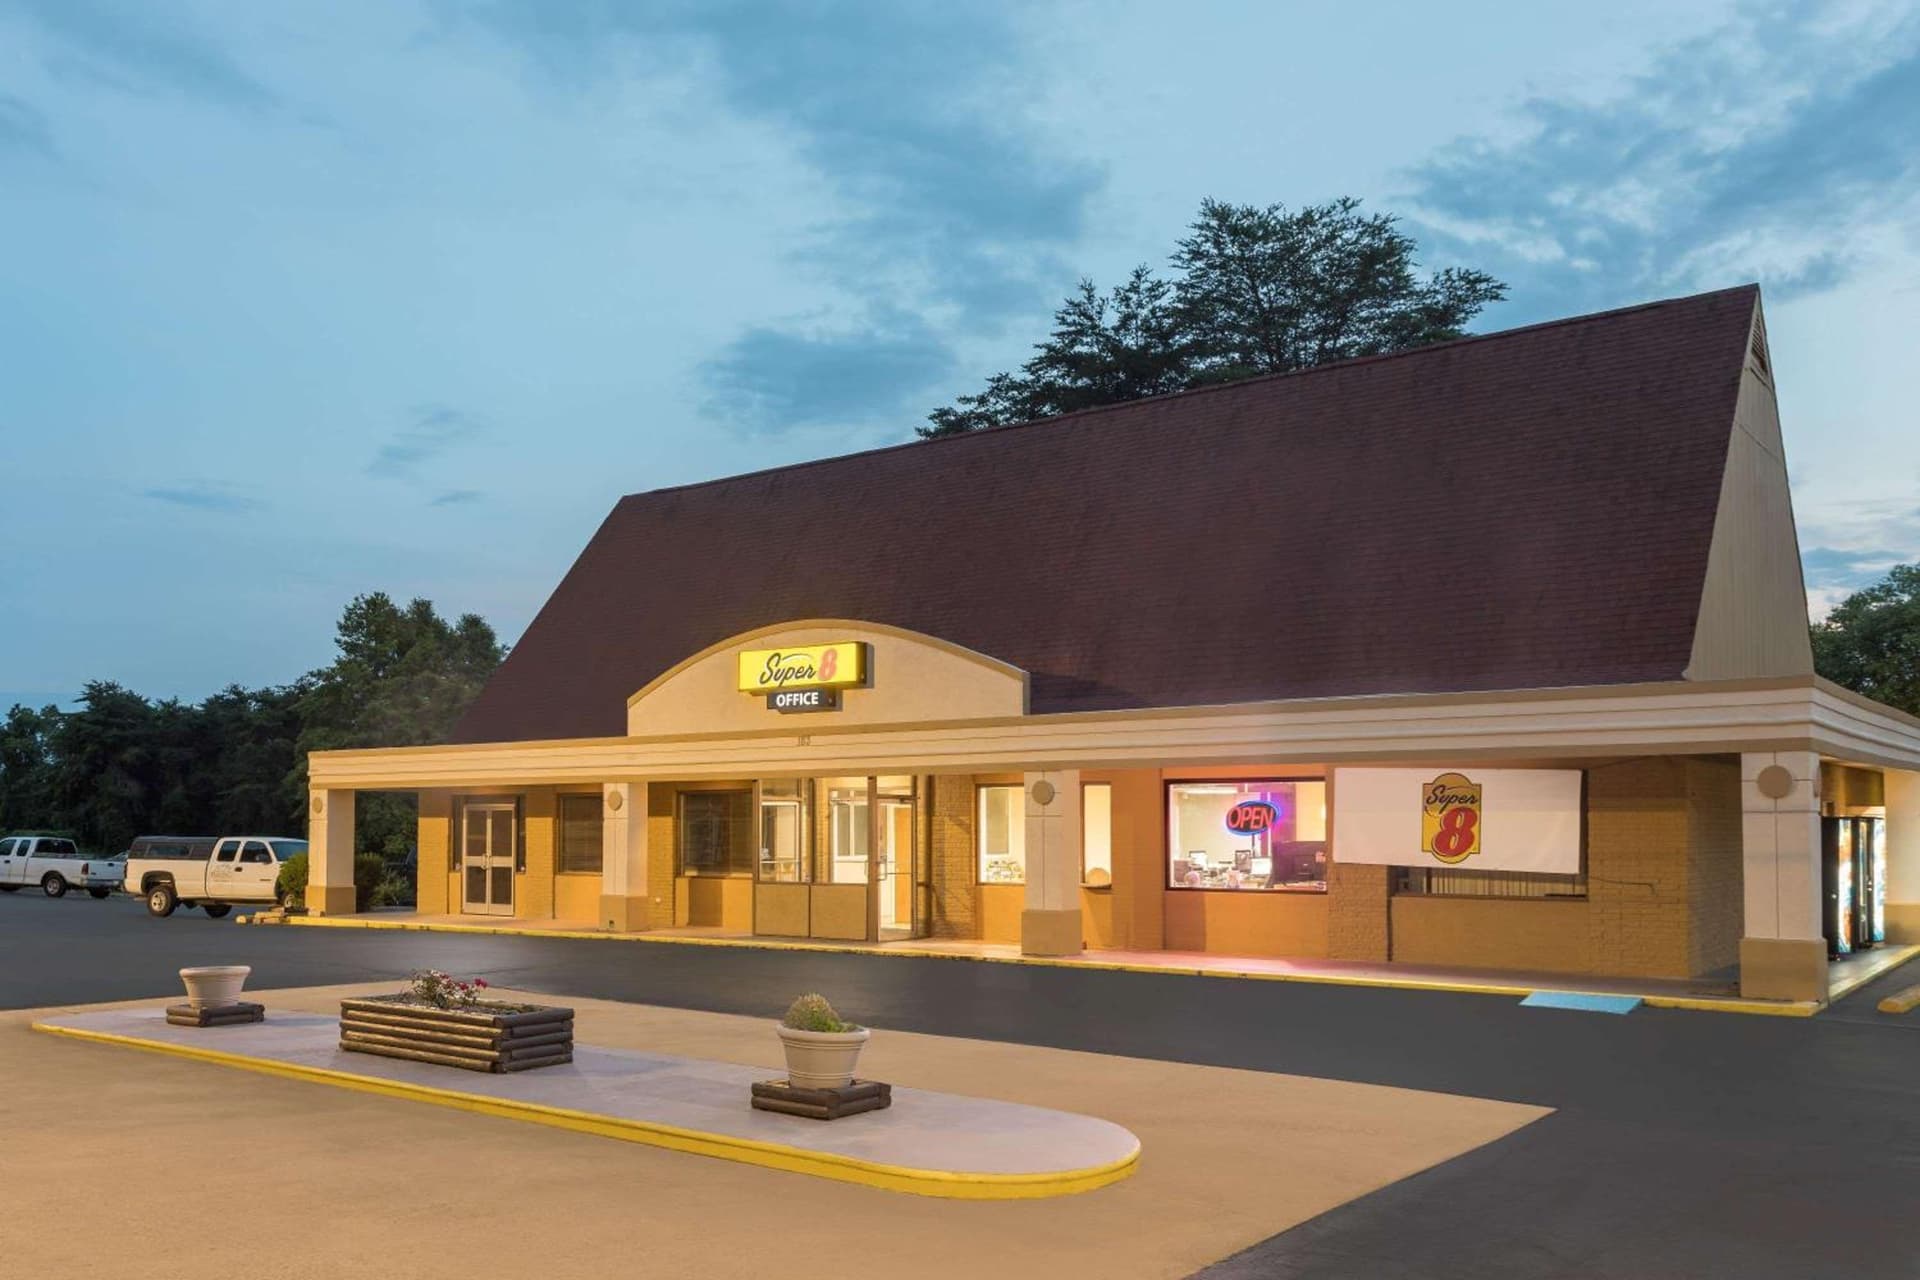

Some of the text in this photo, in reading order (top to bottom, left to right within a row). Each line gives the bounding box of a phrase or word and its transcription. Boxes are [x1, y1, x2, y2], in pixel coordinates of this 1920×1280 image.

[760, 648, 838, 686] Super 8
[776, 692, 819, 707] OFFICE
[1426, 784, 1478, 814] Super
[1228, 807, 1274, 829] OPEN
[1432, 807, 1477, 857] 8
